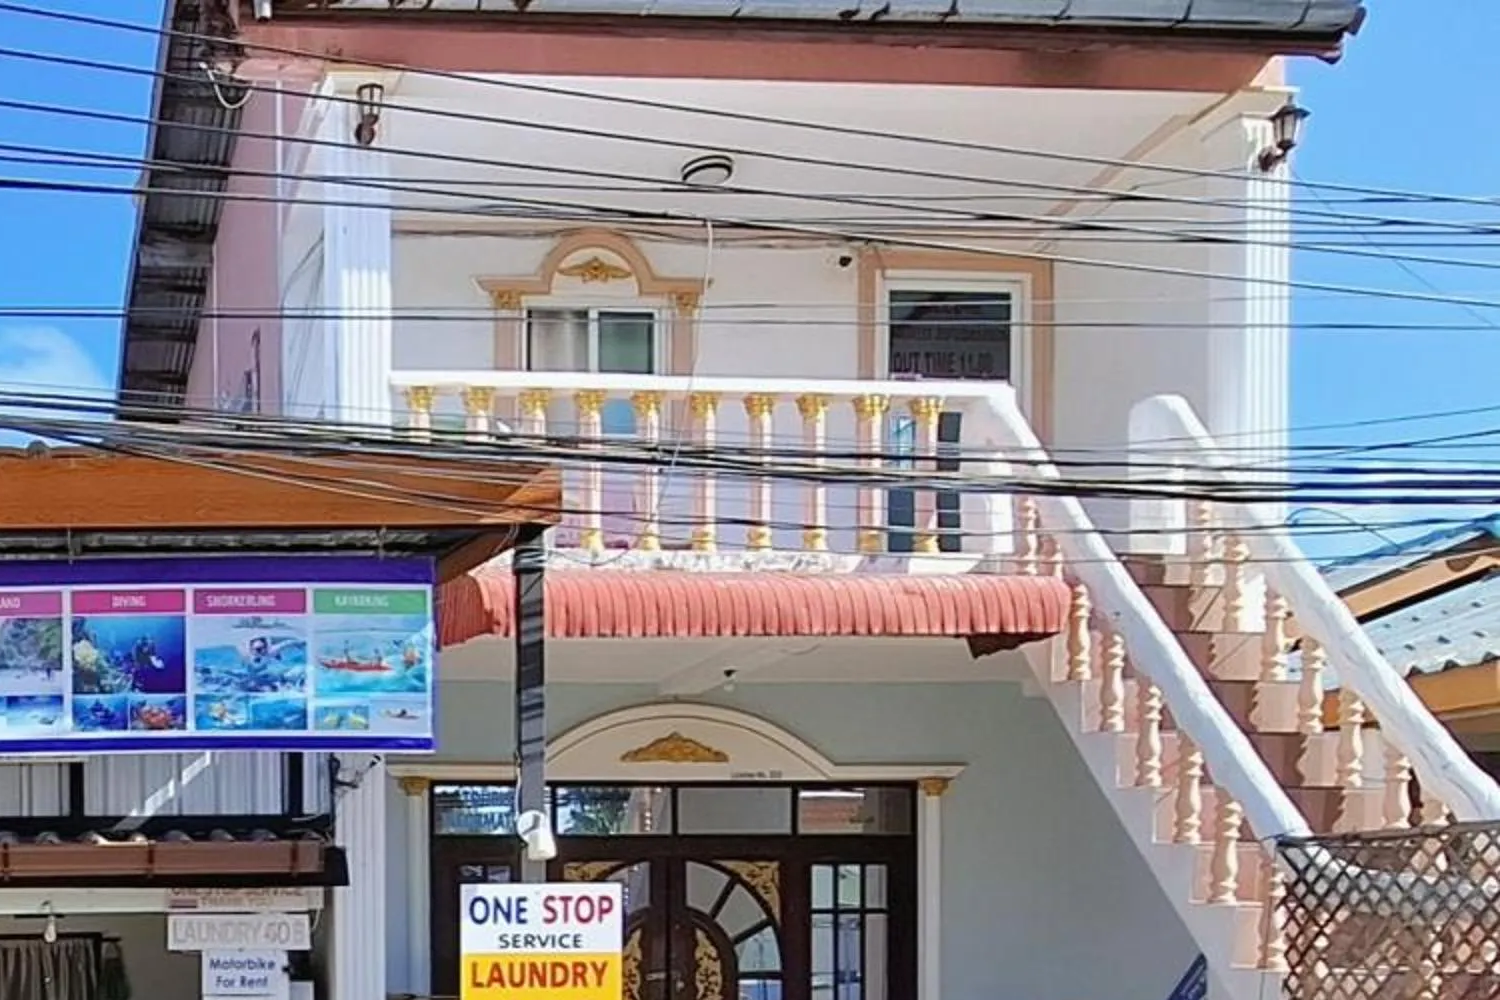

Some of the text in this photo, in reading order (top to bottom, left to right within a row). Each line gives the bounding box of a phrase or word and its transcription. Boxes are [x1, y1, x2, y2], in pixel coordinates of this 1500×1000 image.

[111, 596, 147, 608] DIVING
[469, 894, 614, 925] ONE STOP
[172, 921, 258, 945] LAUNDRY
[499, 933, 582, 949] SERVICE
[209, 957, 276, 971] Motorbike
[216, 974, 268, 987] For Rent
[471, 960, 609, 989] LAUNDRY
